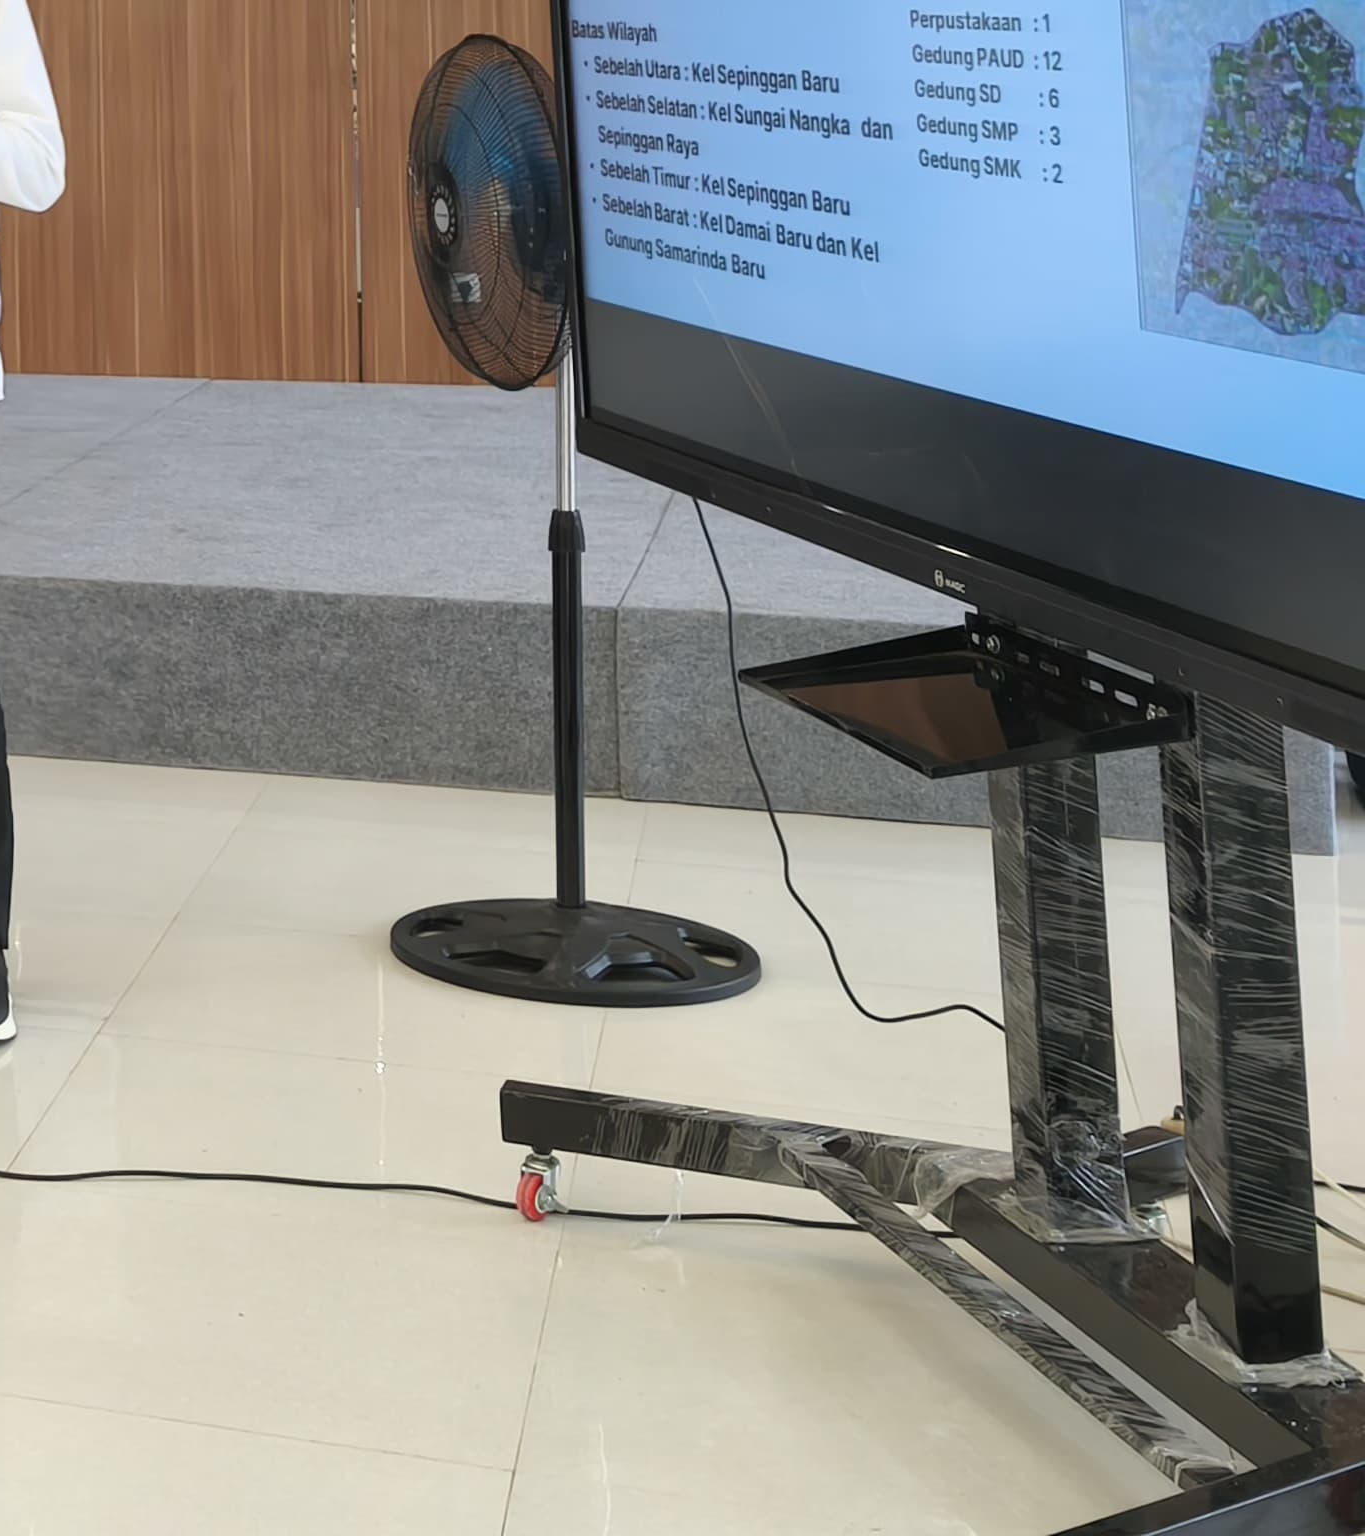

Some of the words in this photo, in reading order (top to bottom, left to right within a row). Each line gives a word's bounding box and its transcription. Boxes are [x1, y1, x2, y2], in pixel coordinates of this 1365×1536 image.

[571, 20, 605, 40] Batas
[607, 21, 658, 46] Wilayah
[909, 10, 1022, 33] Perpustakaan
[594, 55, 643, 77] Sebelah
[645, 60, 681, 81] Utara
[691, 62, 716, 83] Kel
[718, 64, 797, 94] Sepinggan
[802, 69, 840, 94] Baru
[912, 44, 974, 71] Gedung
[976, 47, 1025, 69] PAUD
[1043, 50, 1063, 72] 12
[914, 79, 976, 107] Gedung
[979, 83, 1002, 104] SD
[1048, 88, 1060, 109] 6
[596, 90, 646, 113] Sebelah
[647, 95, 698, 120] Selatan
[708, 100, 732, 123] Kel
[735, 103, 786, 133] Sungai
[789, 109, 851, 139] Nangka
[861, 116, 894, 141] dan
[916, 113, 979, 144] Gedung
[981, 119, 1019, 142] SMP
[1049, 125, 1062, 147] 3
[597, 125, 665, 154] Sepinggan
[666, 133, 700, 160] Raya
[918, 148, 981, 180] Gedung
[983, 155, 1022, 180] SMK
[1052, 163, 1064, 184] 2
[600, 158, 650, 185] Sebelah
[652, 165, 692, 191] Timur
[701, 173, 725, 197] Kel
[727, 178, 808, 212] Sepinggan
[812, 190, 851, 217] Baru
[602, 193, 653, 221] Sebelah
[654, 202, 690, 228] Barat
[700, 210, 724, 235] Kel
[726, 215, 772, 243] Damai
[776, 223, 813, 251] Baru
[816, 231, 847, 258] dan
[851, 236, 880, 264] Kel
[604, 228, 653, 260] Gunung
[656, 238, 728, 272] Samarinda
[731, 253, 767, 280] Baru
